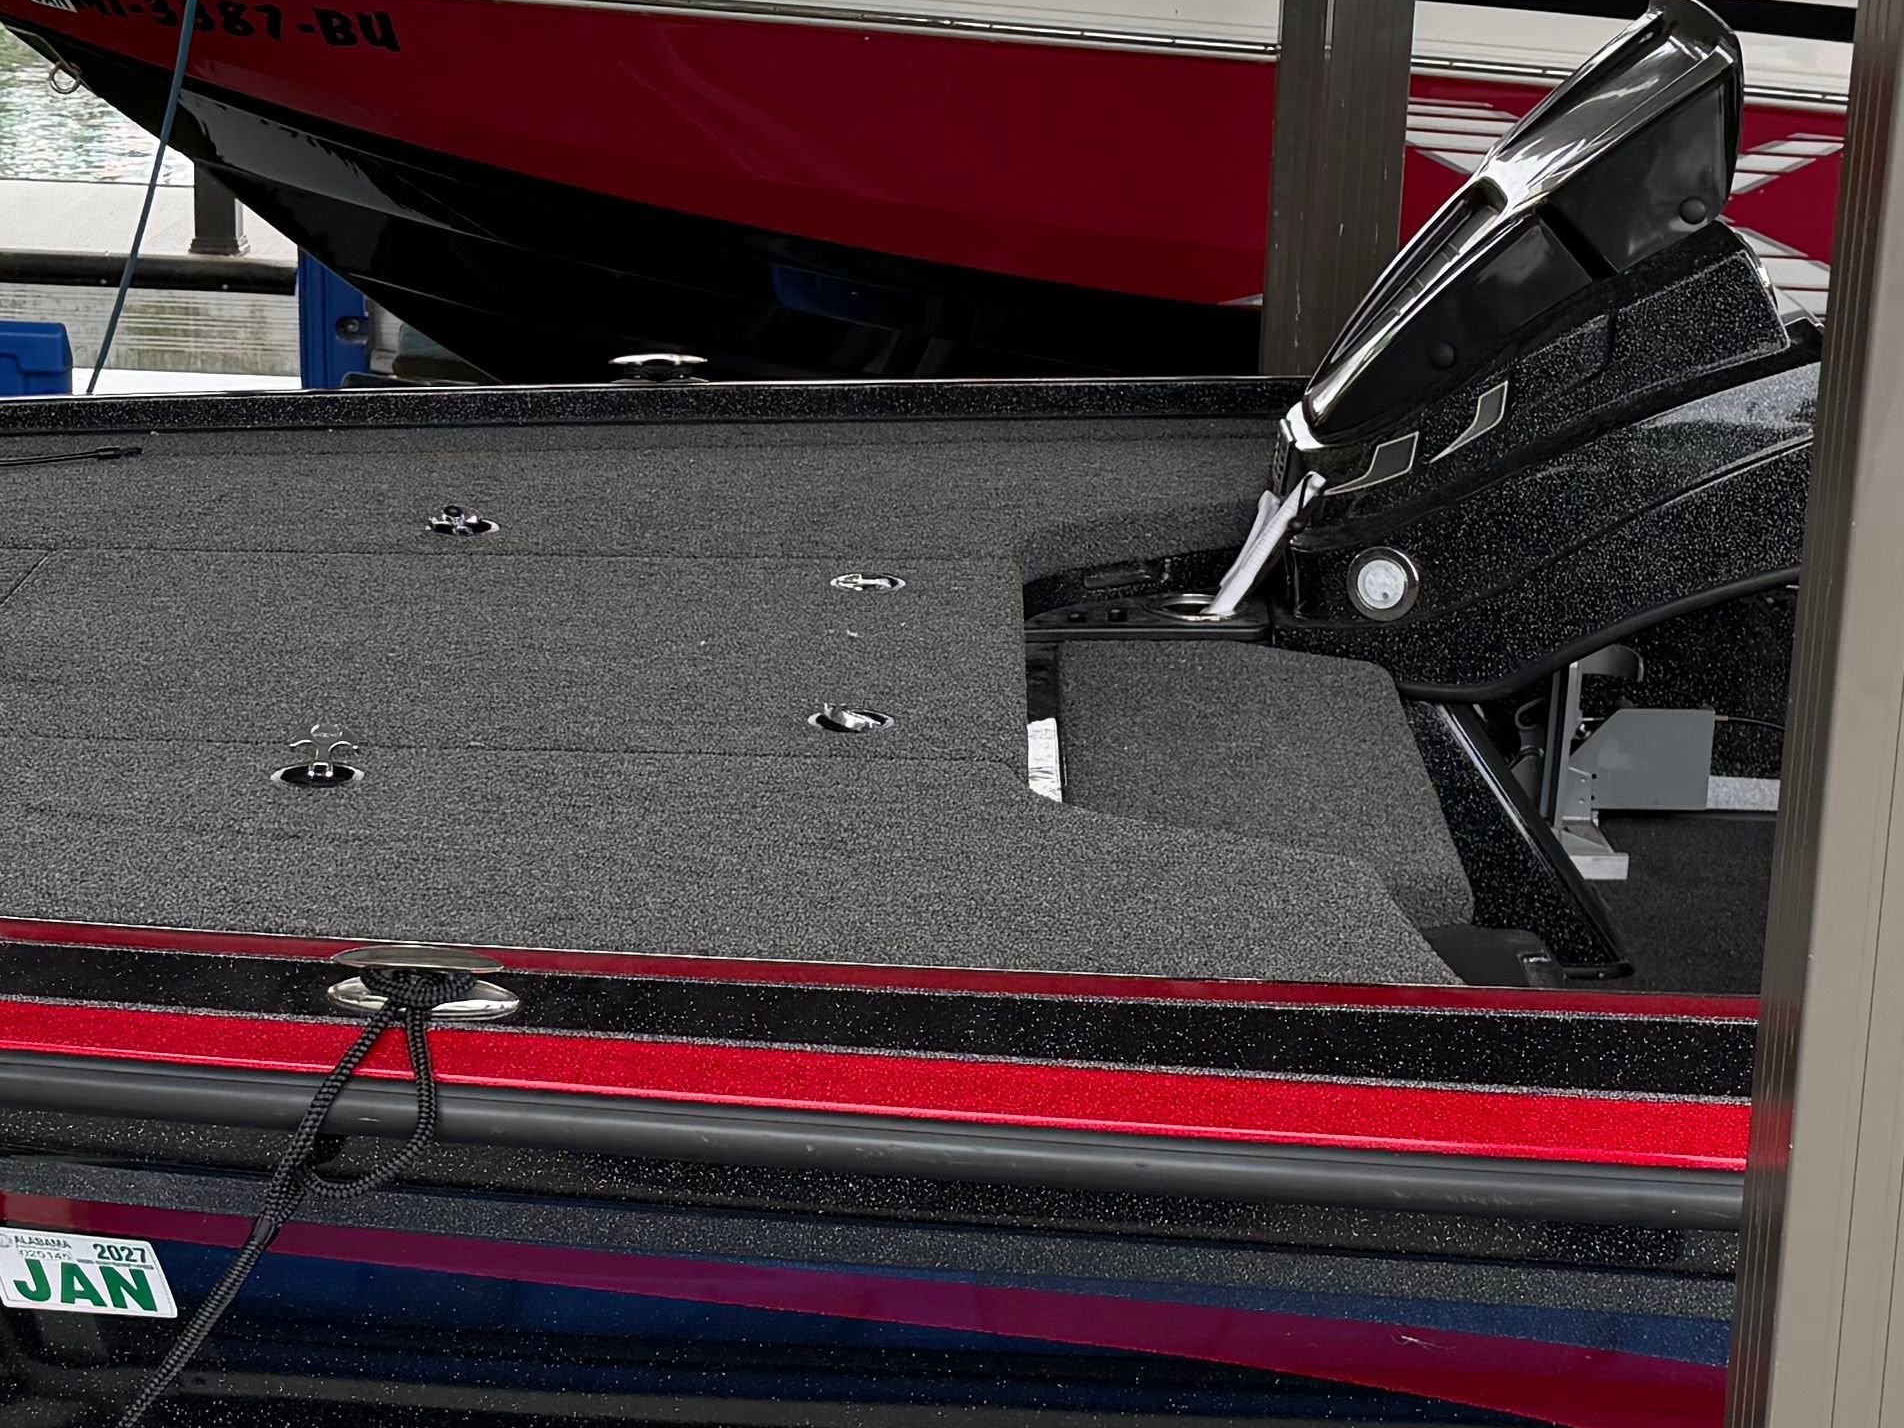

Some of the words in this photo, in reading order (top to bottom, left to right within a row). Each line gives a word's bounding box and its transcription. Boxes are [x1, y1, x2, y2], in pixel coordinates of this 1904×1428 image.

[14, 1235, 73, 1250] ALABAMA
[92, 1243, 147, 1263] 2027
[13, 1257, 158, 1312] JAN
